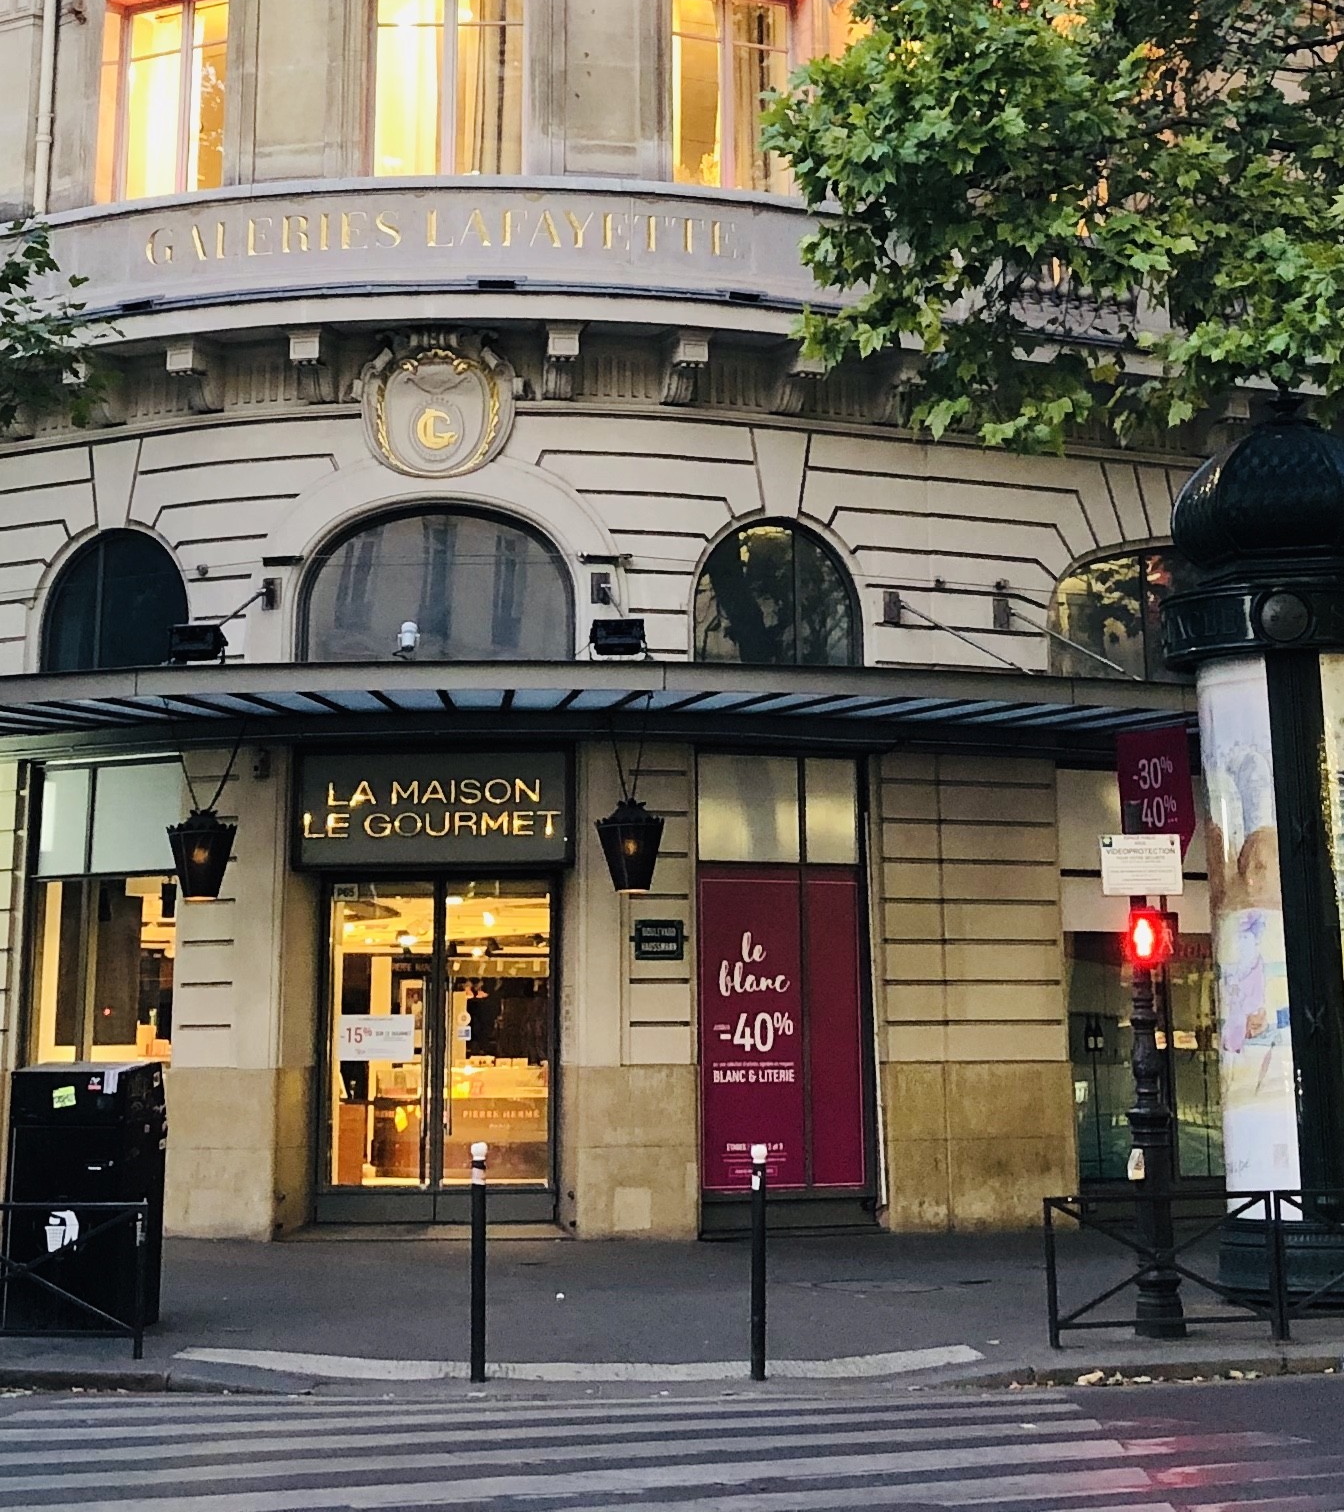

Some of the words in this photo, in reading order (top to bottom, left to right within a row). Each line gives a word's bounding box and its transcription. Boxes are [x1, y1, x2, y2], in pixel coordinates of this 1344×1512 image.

[145, 210, 402, 265] GALERIES
[426, 207, 738, 257] LAFAYETTE
[1132, 756, 1174, 790] -30%
[327, 780, 377, 807] LA
[390, 778, 541, 805] MAISON
[303, 812, 350, 838] LE
[363, 811, 561, 838] GOURMET
[741, 931, 767, 963] le
[719, 959, 791, 997] blanc
[719, 1012, 794, 1053] -40%
[713, 1069, 746, 1083] BLANC
[758, 1069, 795, 1083] LITERIE
